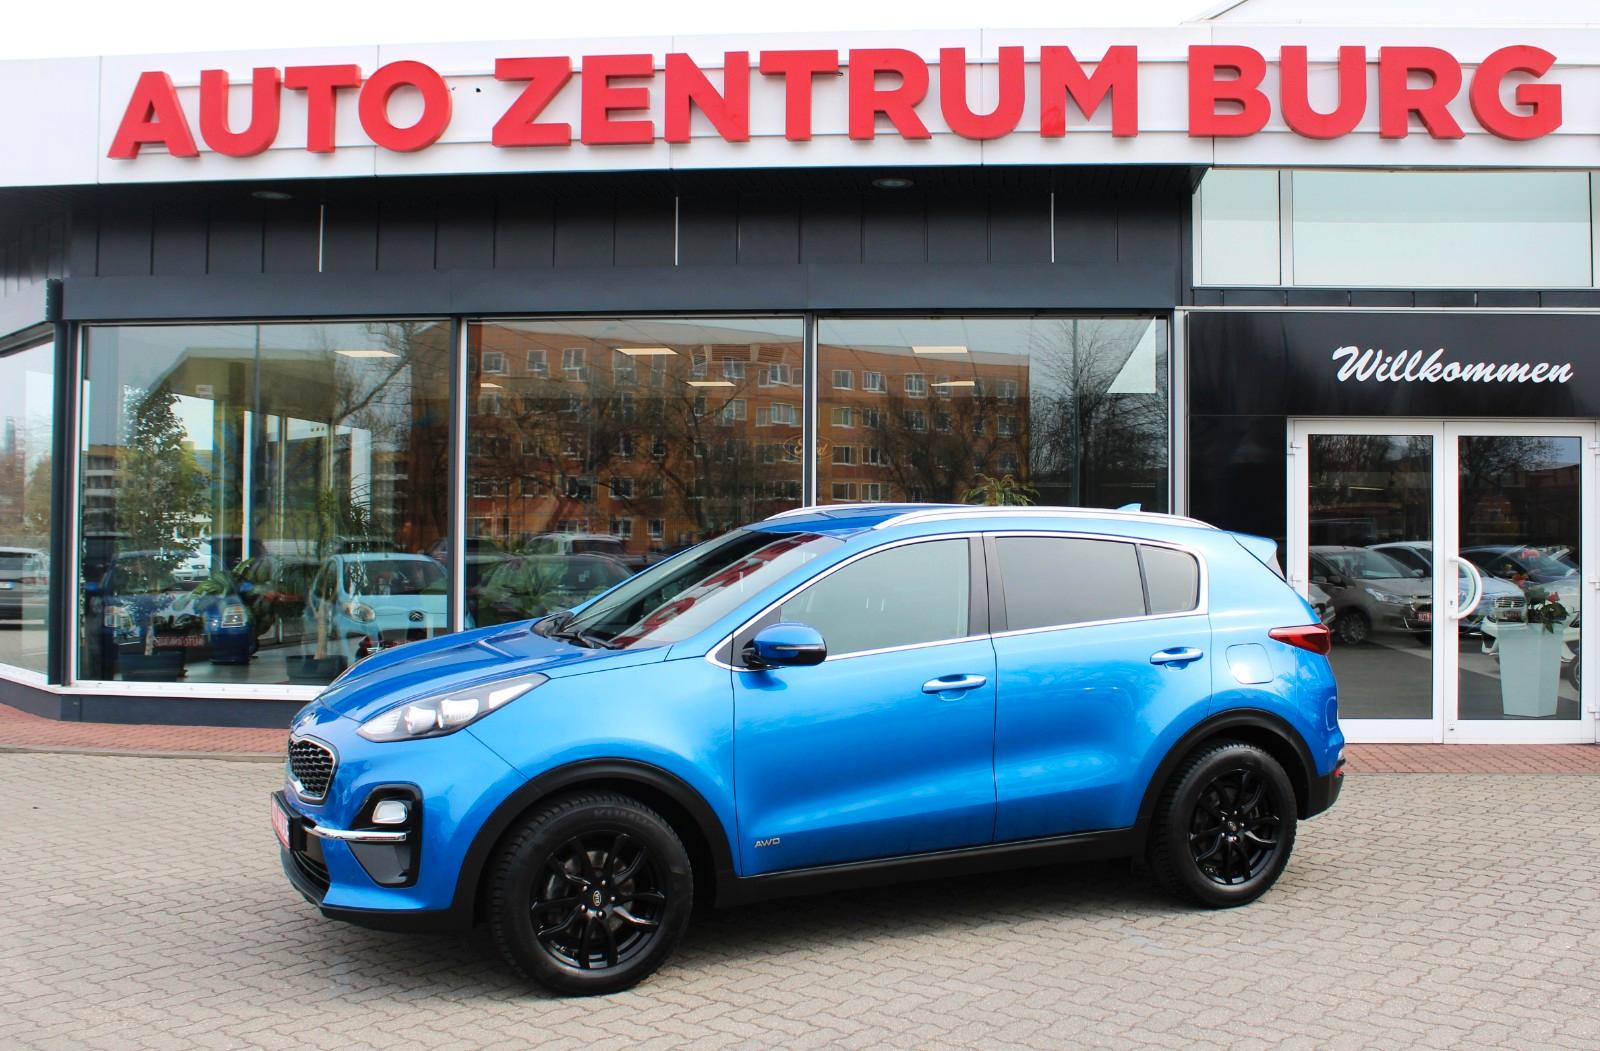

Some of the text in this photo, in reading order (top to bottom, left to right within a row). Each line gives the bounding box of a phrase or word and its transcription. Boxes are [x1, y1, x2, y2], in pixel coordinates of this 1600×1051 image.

[108, 44, 1563, 160] AUTO ZENTRUM BURG
[1332, 346, 1574, 383] Willkommen
[754, 837, 781, 849] AWD
